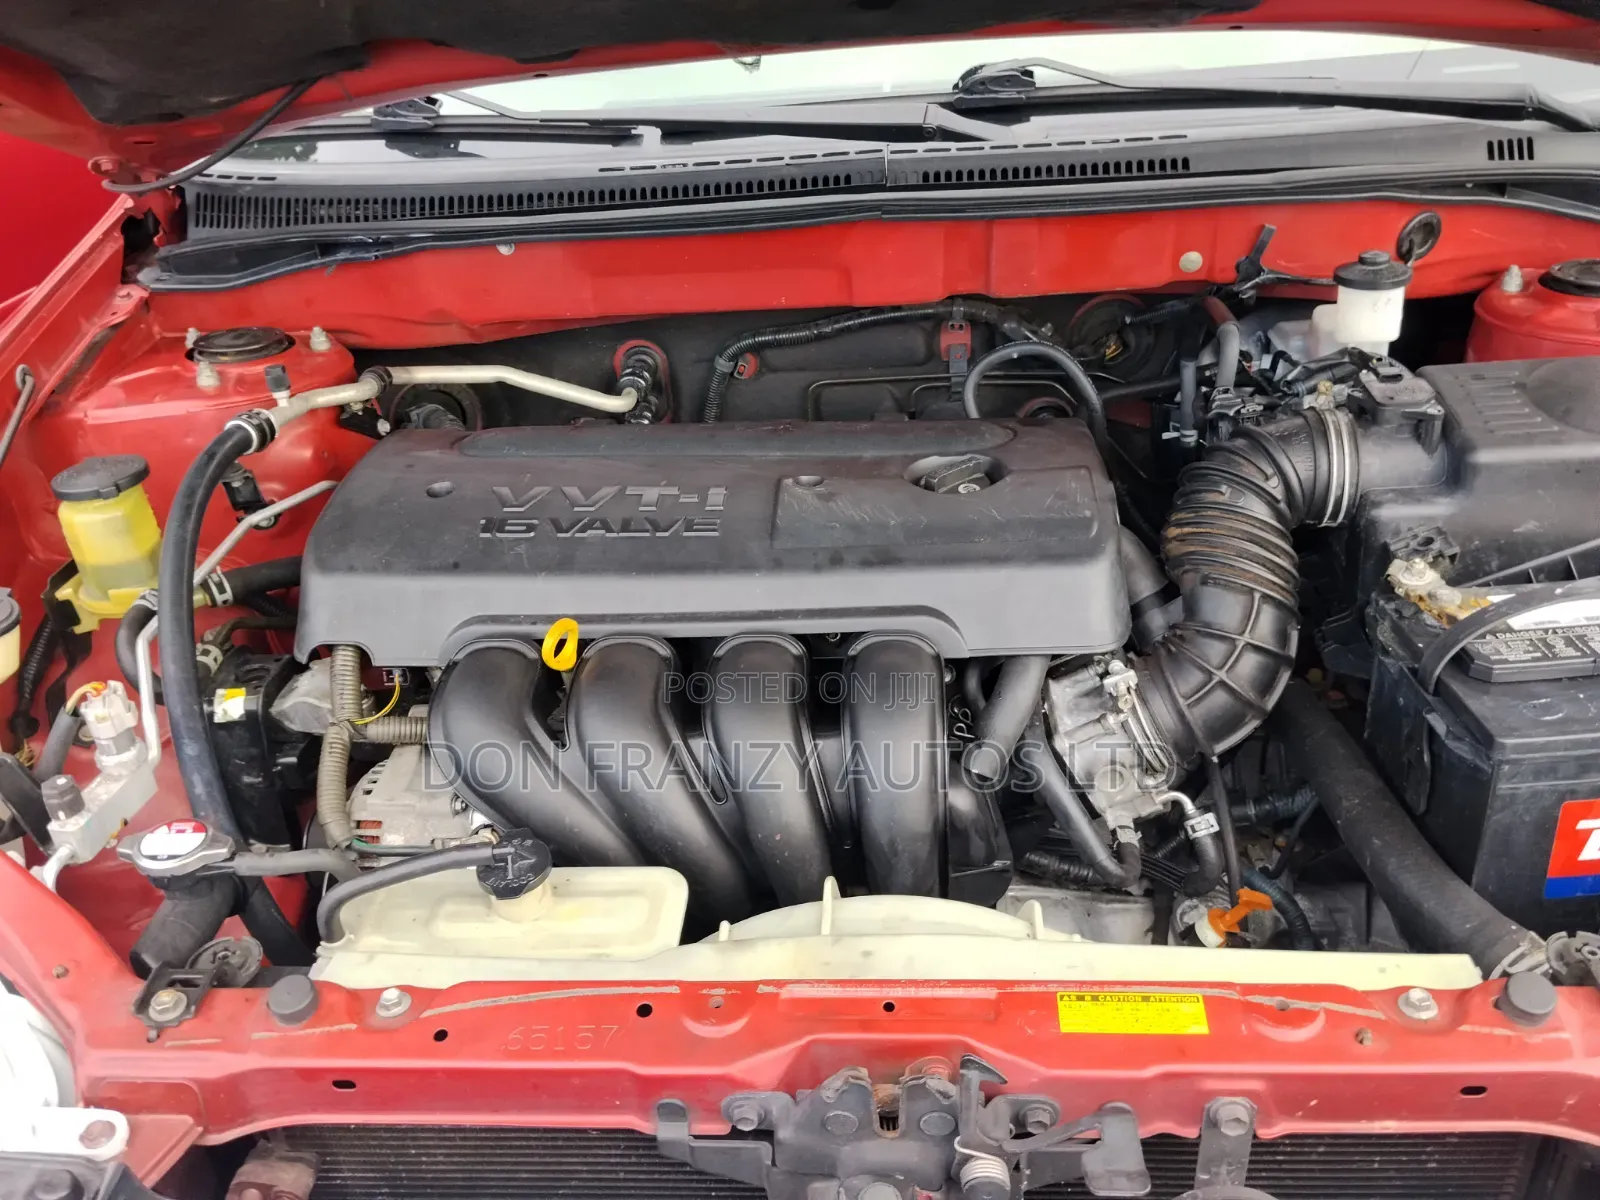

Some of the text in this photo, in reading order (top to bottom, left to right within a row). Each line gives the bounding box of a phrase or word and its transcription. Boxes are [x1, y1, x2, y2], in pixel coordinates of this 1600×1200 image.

[479, 516, 720, 538] 16 VALVE
[1496, 628, 1545, 640] DANGER
